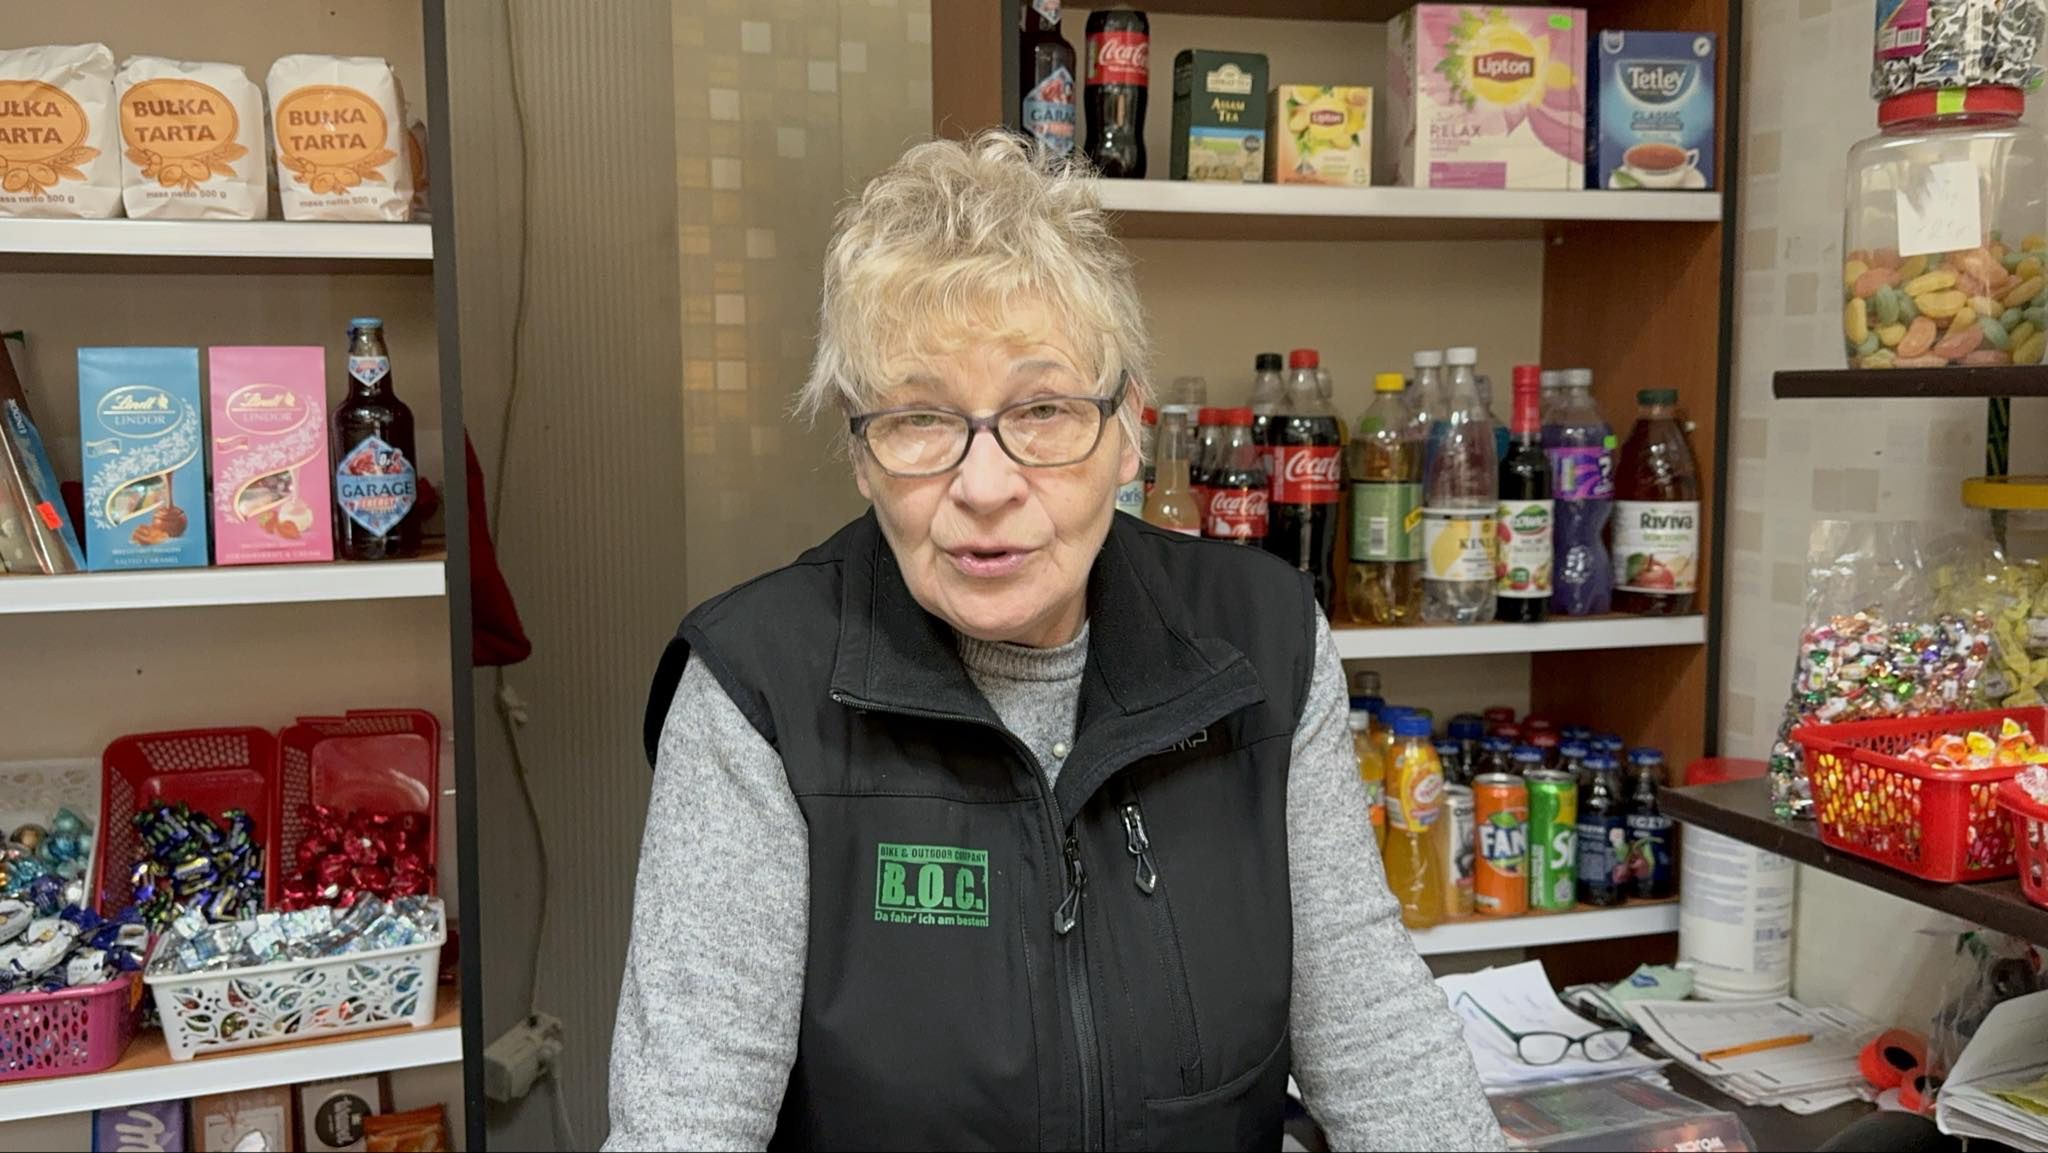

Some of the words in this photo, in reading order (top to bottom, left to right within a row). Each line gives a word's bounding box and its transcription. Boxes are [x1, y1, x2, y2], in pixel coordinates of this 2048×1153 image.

[1477, 58, 1531, 76] Lipton
[1628, 67, 1686, 96] Tetley
[132, 99, 215, 117] BUŁKA
[288, 108, 367, 126] BUŁKA
[134, 125, 217, 142] TARTA
[1430, 125, 1480, 138] RELAX
[289, 133, 368, 151] TARTA
[67, 195, 76, 204] g
[111, 394, 157, 410] Lindt
[114, 414, 167, 425] LINDOR
[342, 481, 413, 498] GARAGE
[880, 846, 899, 857] BIKE
[901, 848, 909, 858] &
[911, 848, 953, 859] OUTDOOR
[881, 862, 984, 910] B.O.C.
[875, 911, 889, 921] Da
[918, 913, 936, 925] ich
[937, 916, 955, 925] am
